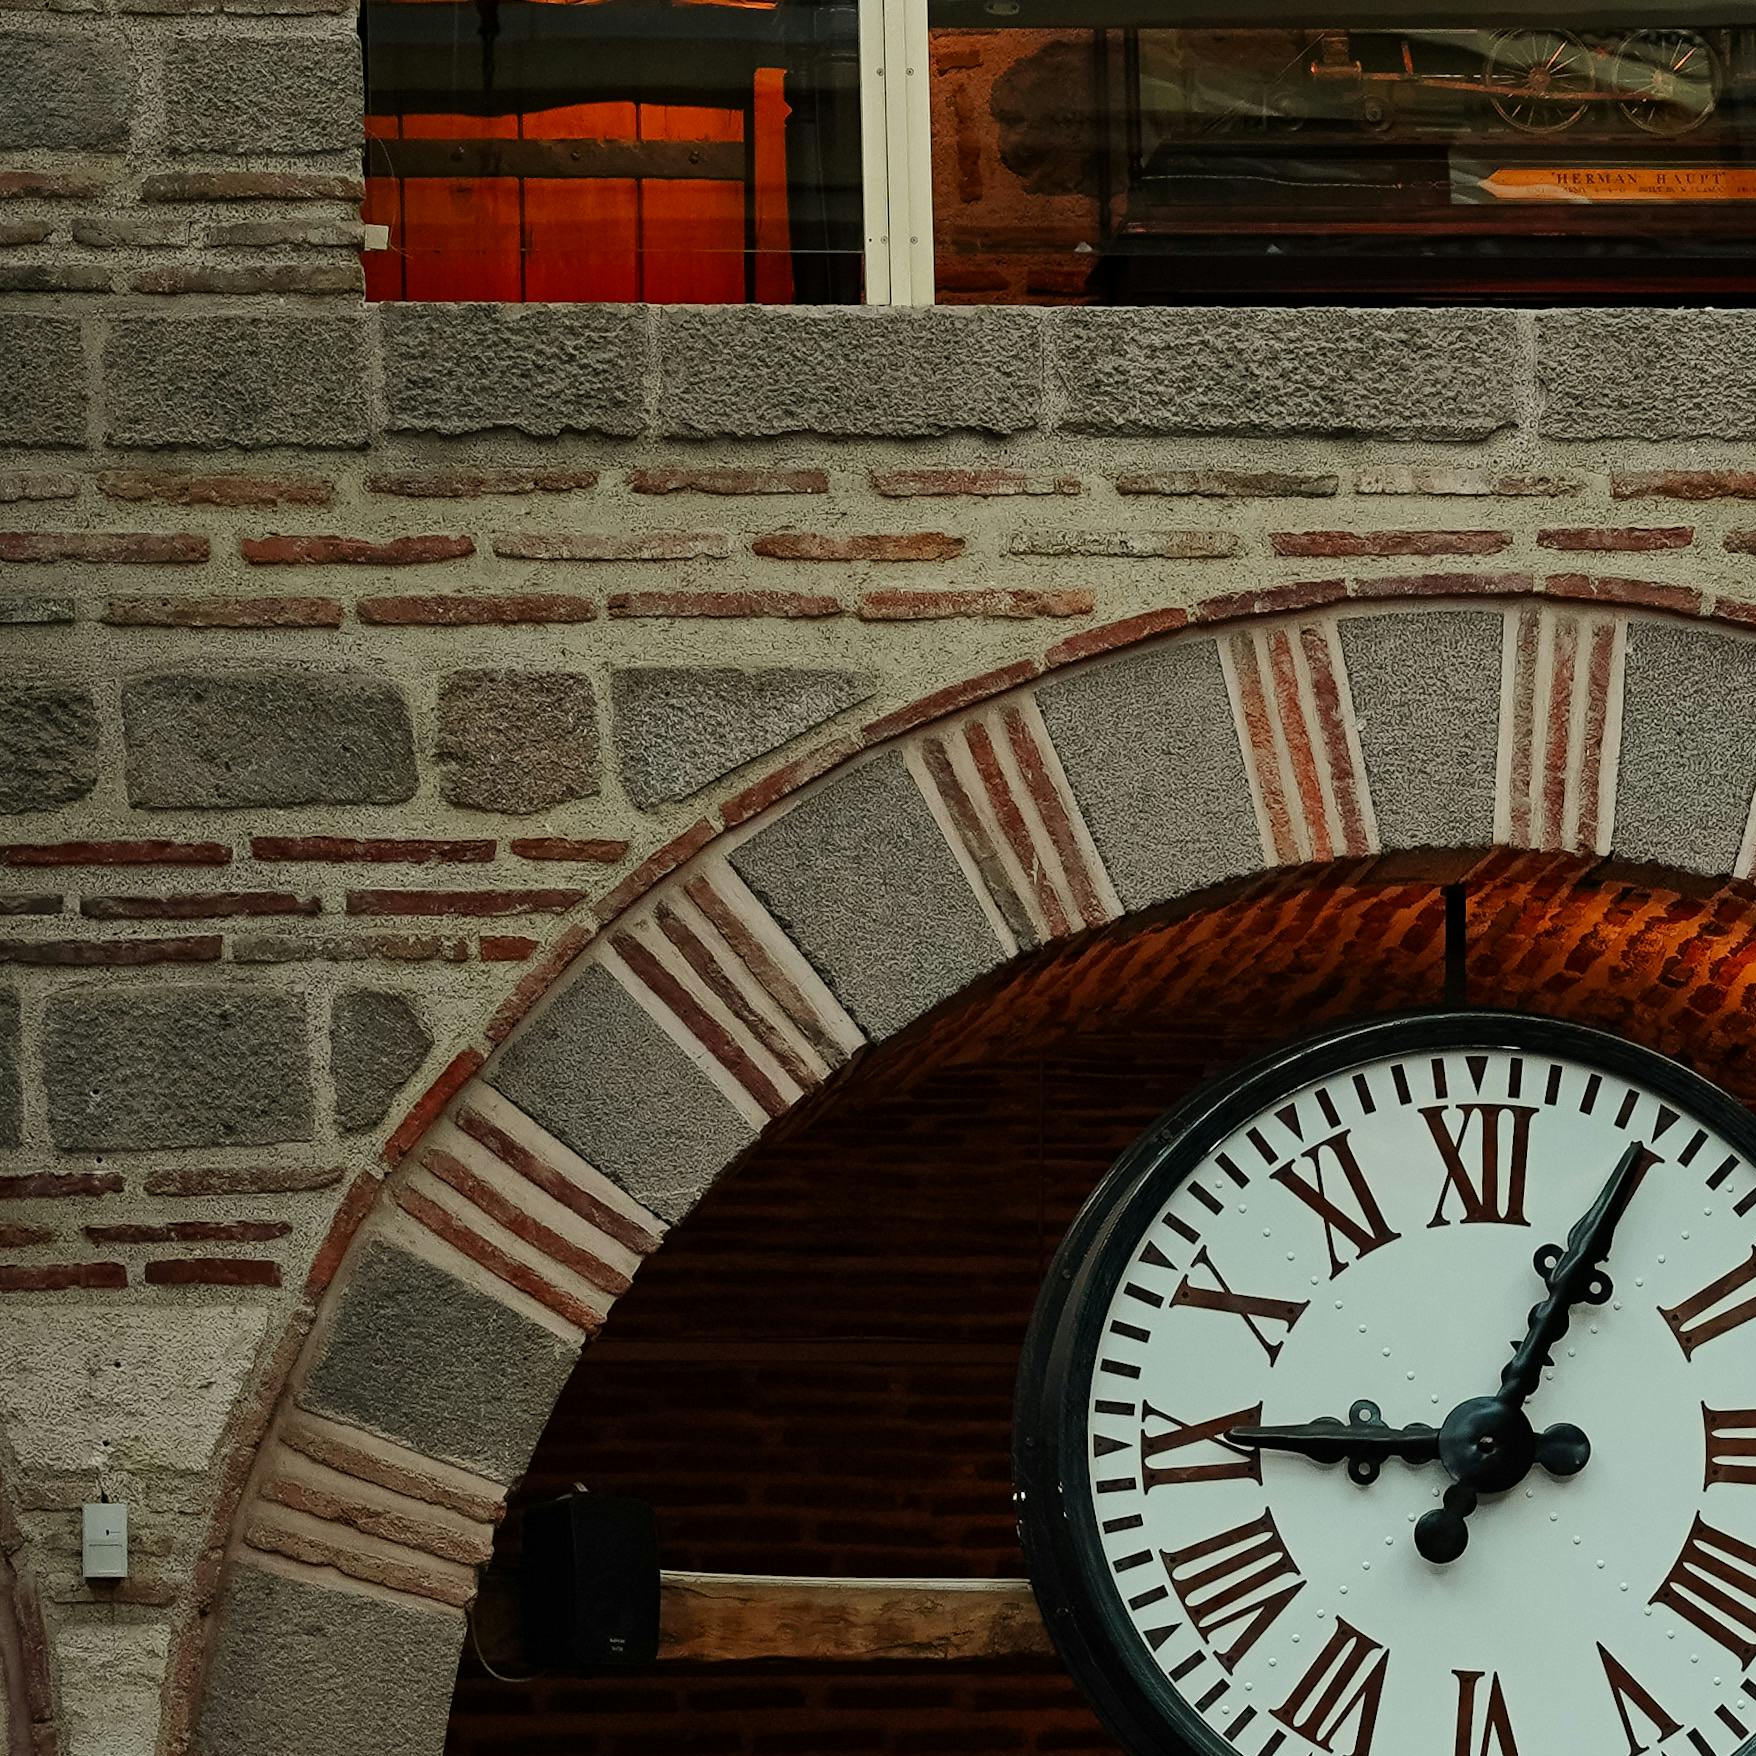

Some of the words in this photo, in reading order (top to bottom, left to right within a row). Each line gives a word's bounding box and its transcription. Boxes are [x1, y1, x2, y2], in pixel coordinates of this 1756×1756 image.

[1269, 1129, 1402, 1281] XI
[1417, 1104, 1540, 1228] XII
[1169, 1245, 1311, 1367] X
[1140, 1398, 1264, 1496] IX
[1159, 1506, 1307, 1676] VIII
